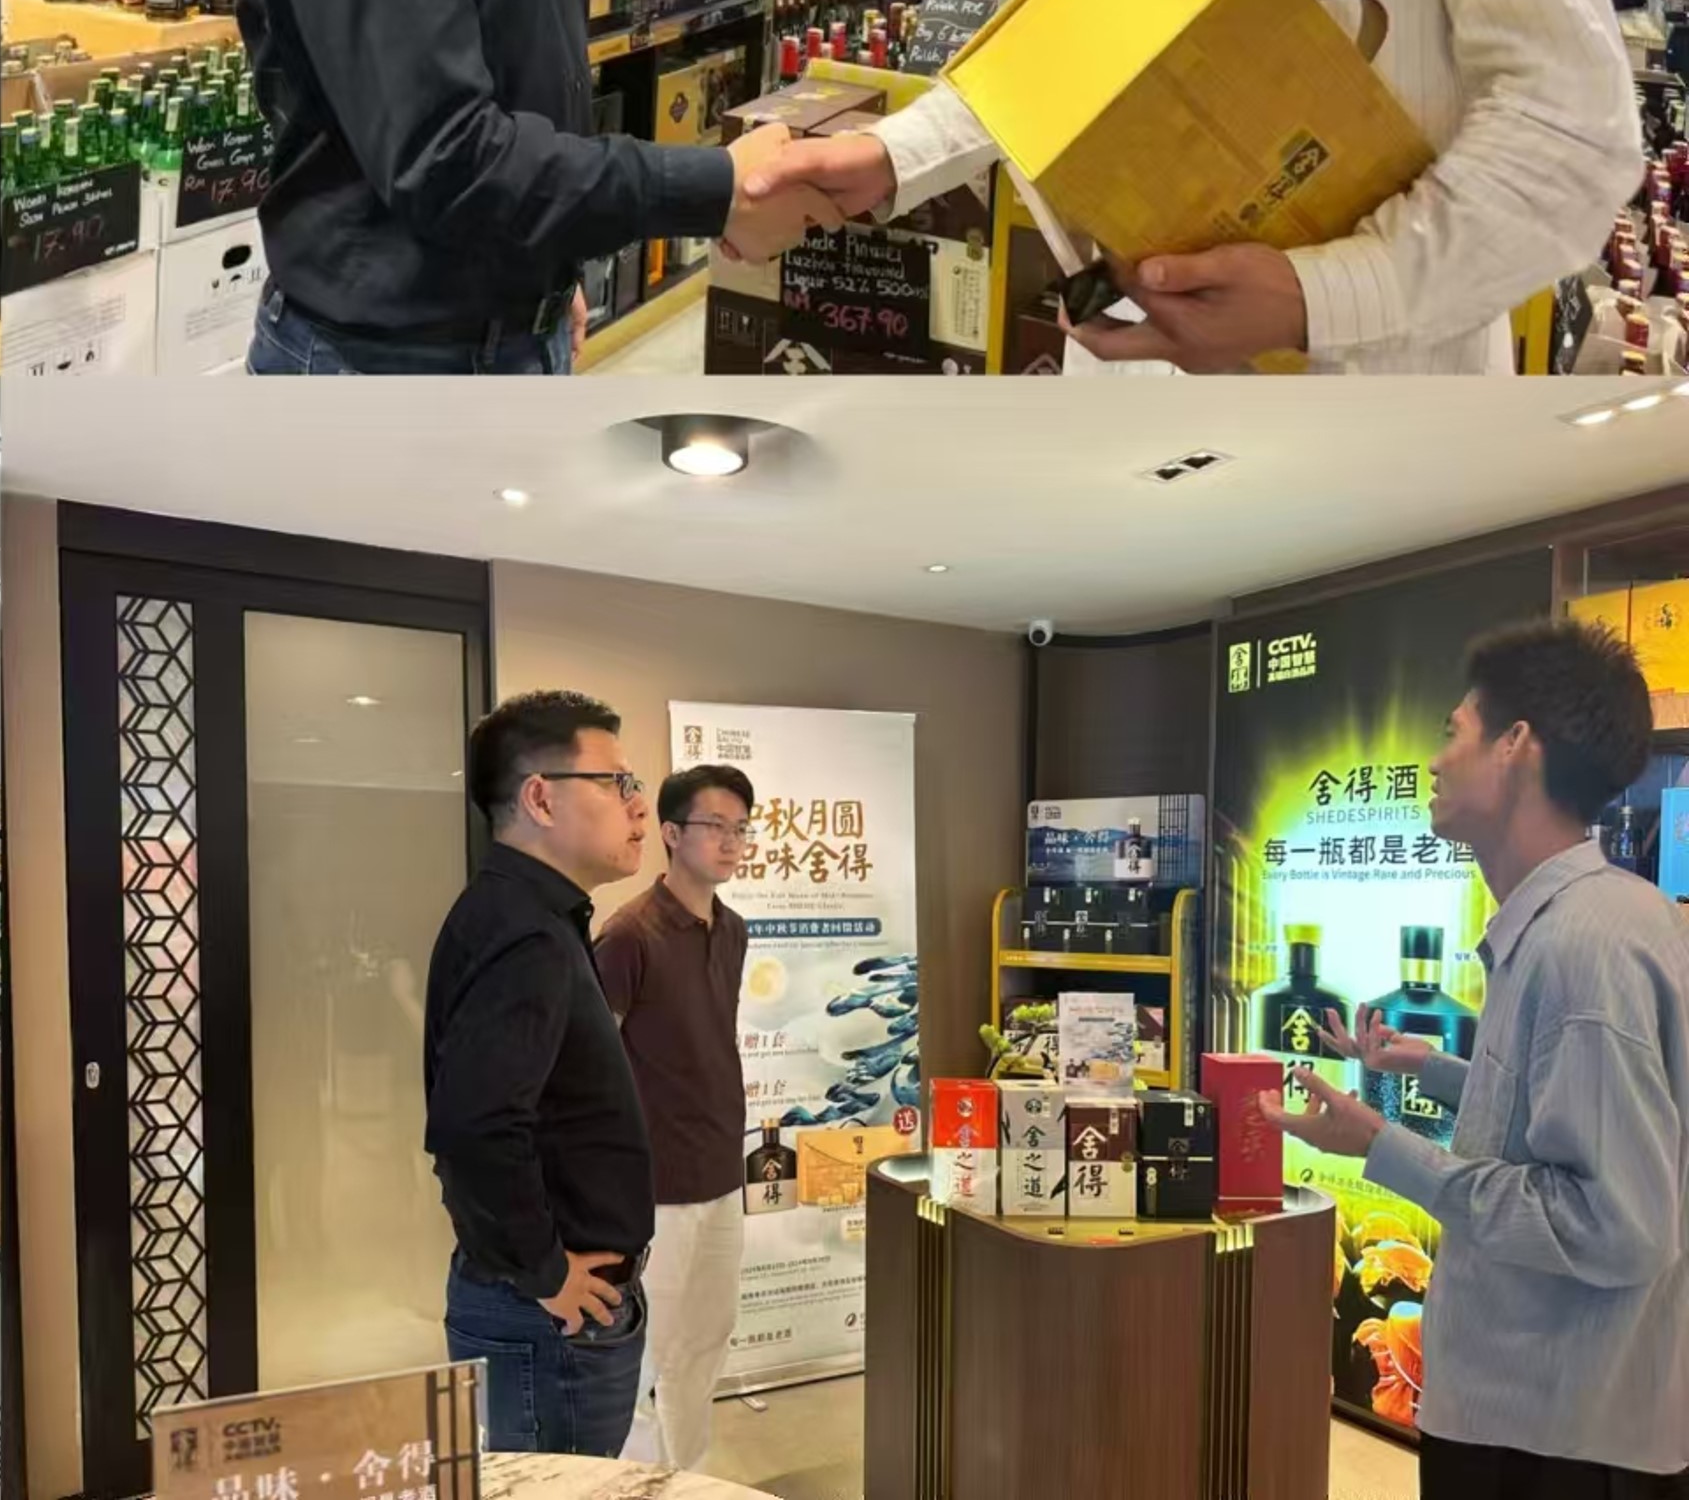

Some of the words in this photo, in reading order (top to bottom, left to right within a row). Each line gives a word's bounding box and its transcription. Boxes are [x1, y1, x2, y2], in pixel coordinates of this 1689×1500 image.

[896, 1110, 915, 1131] 送
[1022, 1124, 1047, 1199] 舍之道
[1073, 1125, 1108, 1199] 舍得
